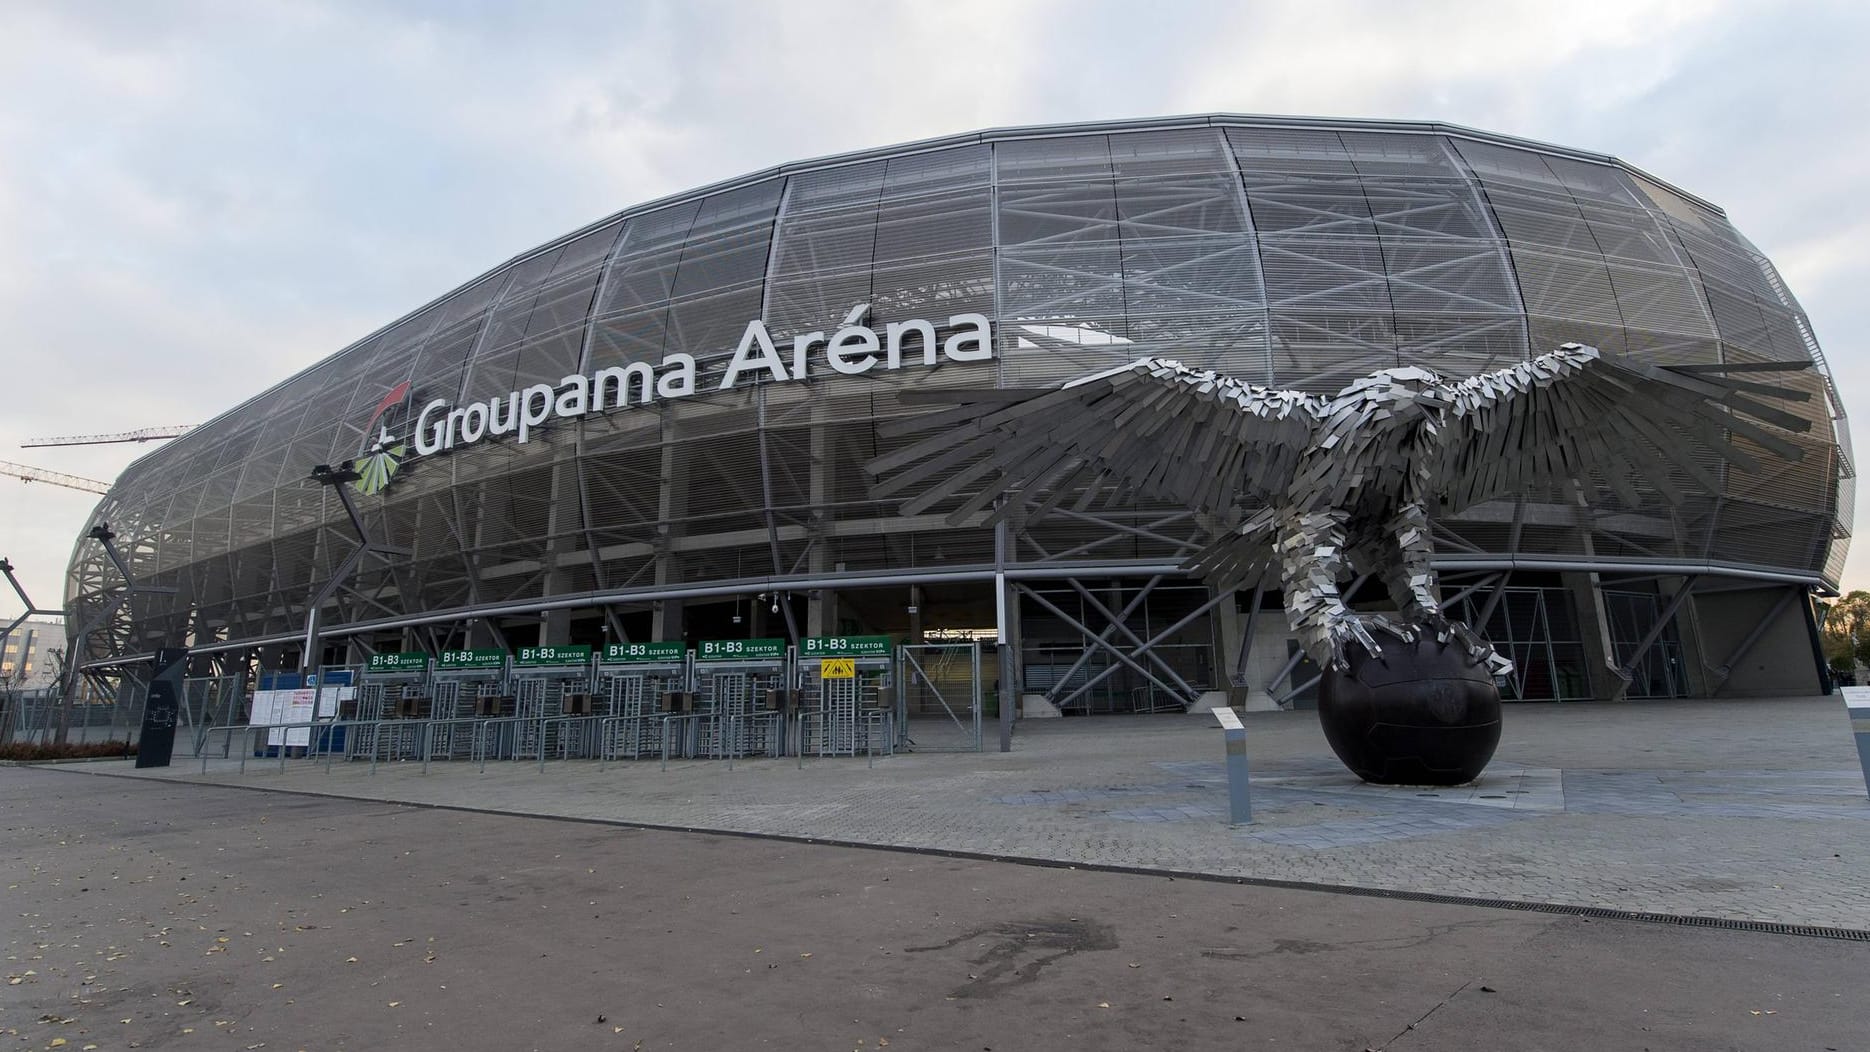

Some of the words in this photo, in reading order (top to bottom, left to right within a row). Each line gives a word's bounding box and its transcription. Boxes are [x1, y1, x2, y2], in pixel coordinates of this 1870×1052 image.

[415, 352, 696, 456] Groupama
[719, 303, 993, 390] Aréna
[704, 642, 743, 653] B1-B3
[807, 639, 847, 650] B1-B3
[522, 648, 555, 659] B1-B3
[609, 645, 646, 656] B1-B3
[372, 655, 399, 665] B1-B3
[443, 652, 473, 662] B1-B3
